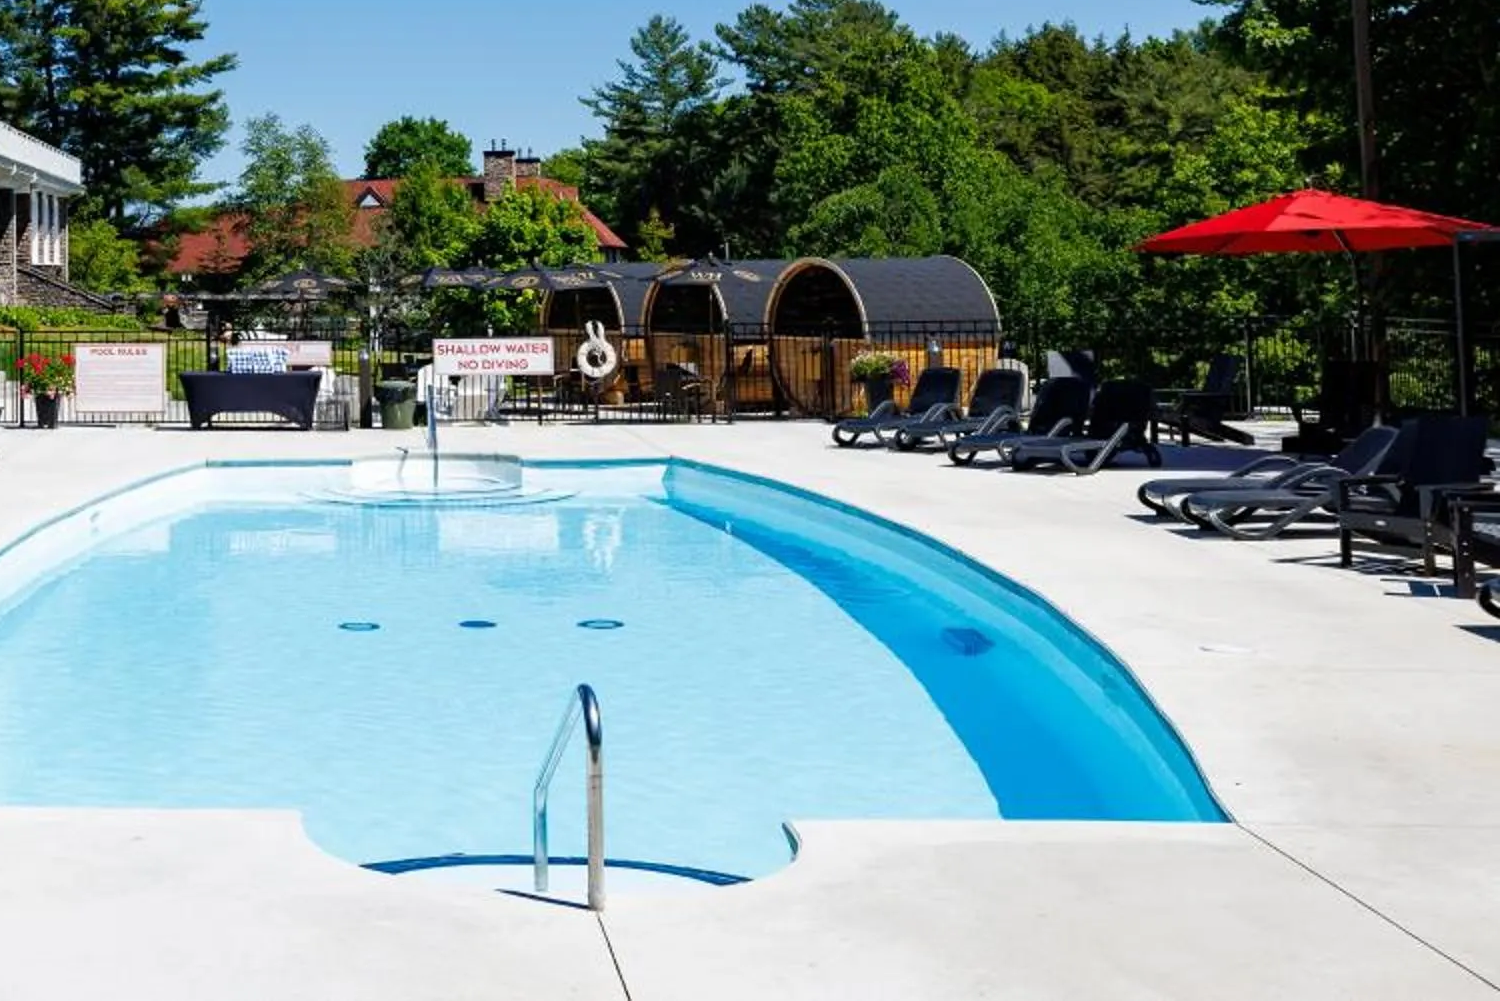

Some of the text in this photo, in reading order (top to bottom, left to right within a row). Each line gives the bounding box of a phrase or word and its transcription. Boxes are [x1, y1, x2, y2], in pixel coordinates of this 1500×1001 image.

[437, 343, 549, 355] SHALLOW WATER
[458, 359, 529, 370] NO DIVING
